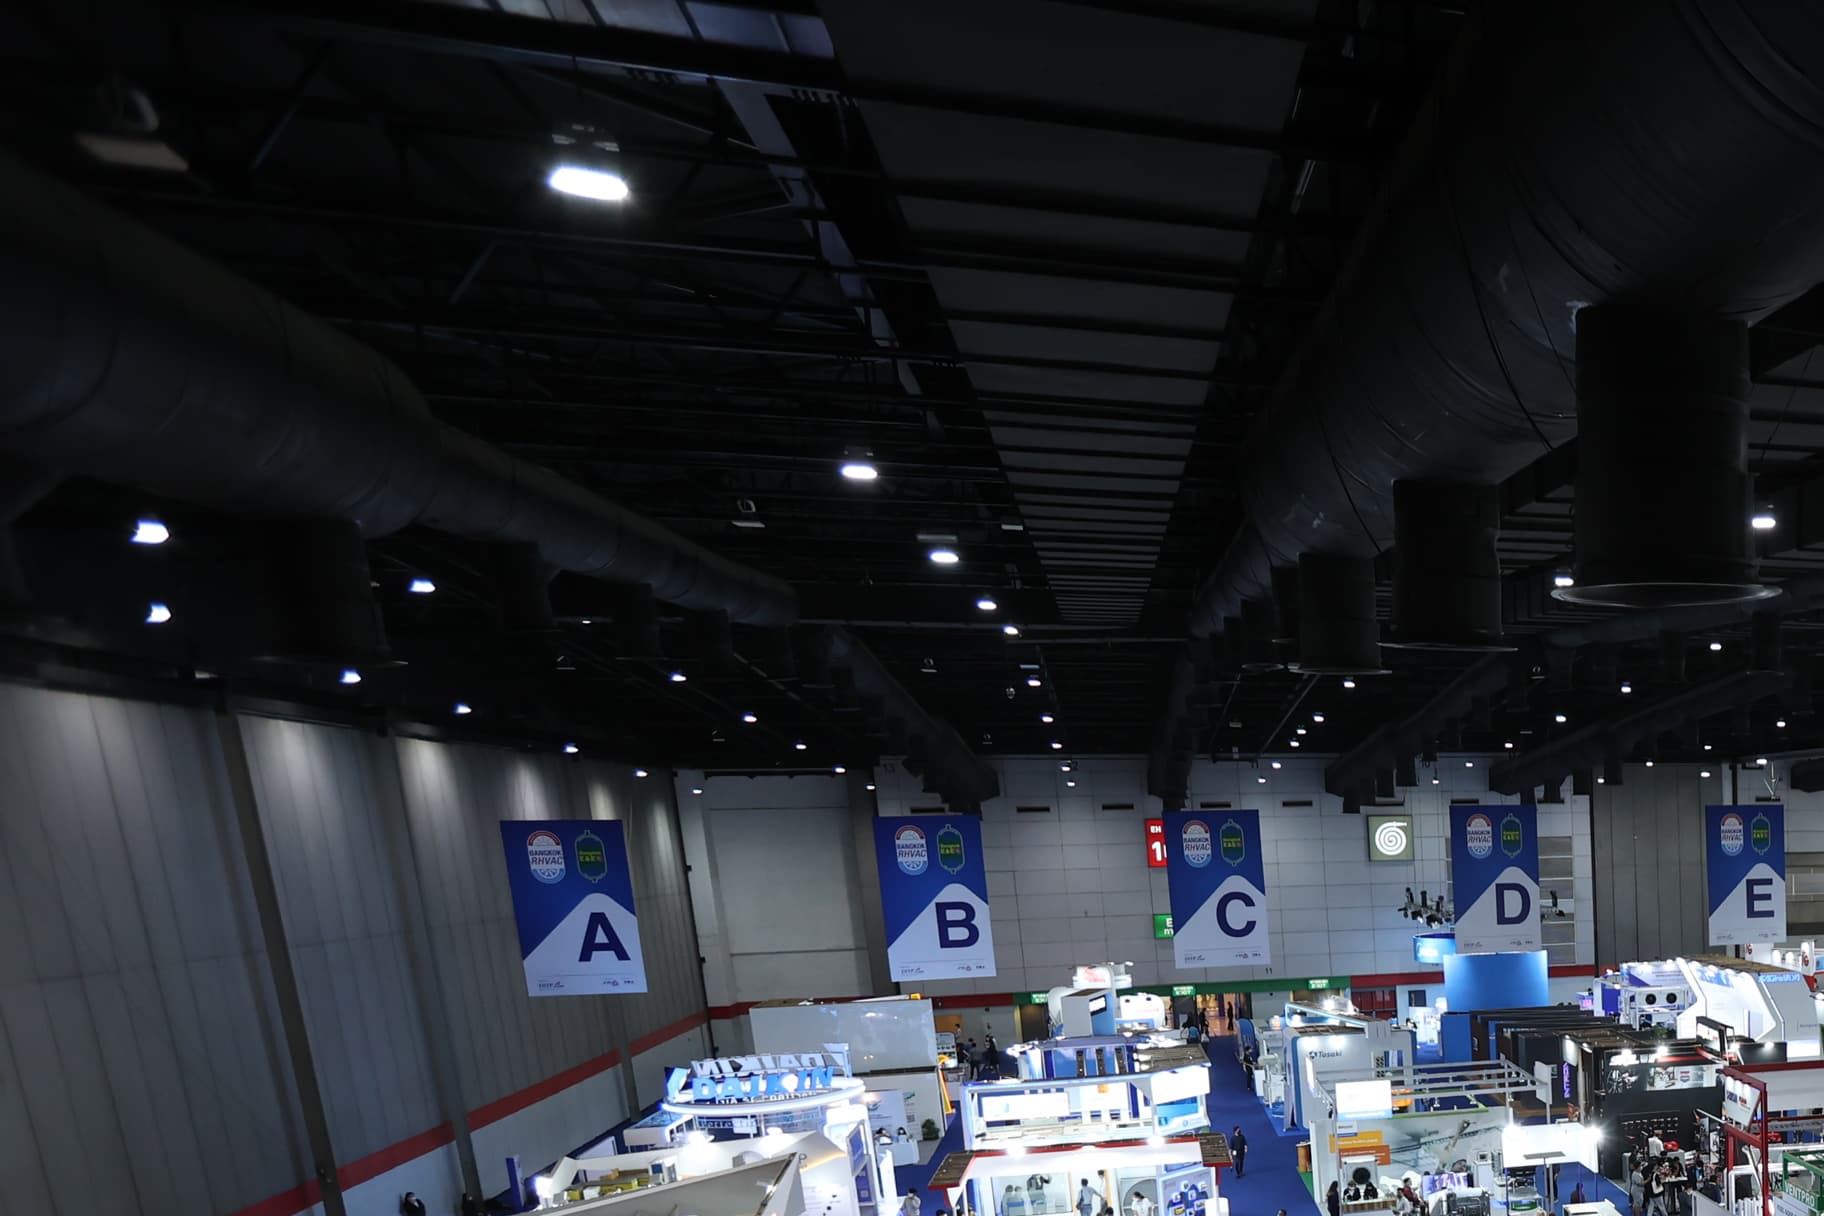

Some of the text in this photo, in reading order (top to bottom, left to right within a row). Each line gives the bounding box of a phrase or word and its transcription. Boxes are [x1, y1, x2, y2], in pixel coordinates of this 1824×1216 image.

[531, 857, 563, 866] RHVAC
[1216, 891, 1256, 937] C
[1495, 883, 1531, 925] D
[1746, 878, 1775, 918] E
[578, 912, 631, 962] A
[935, 901, 979, 948] B
